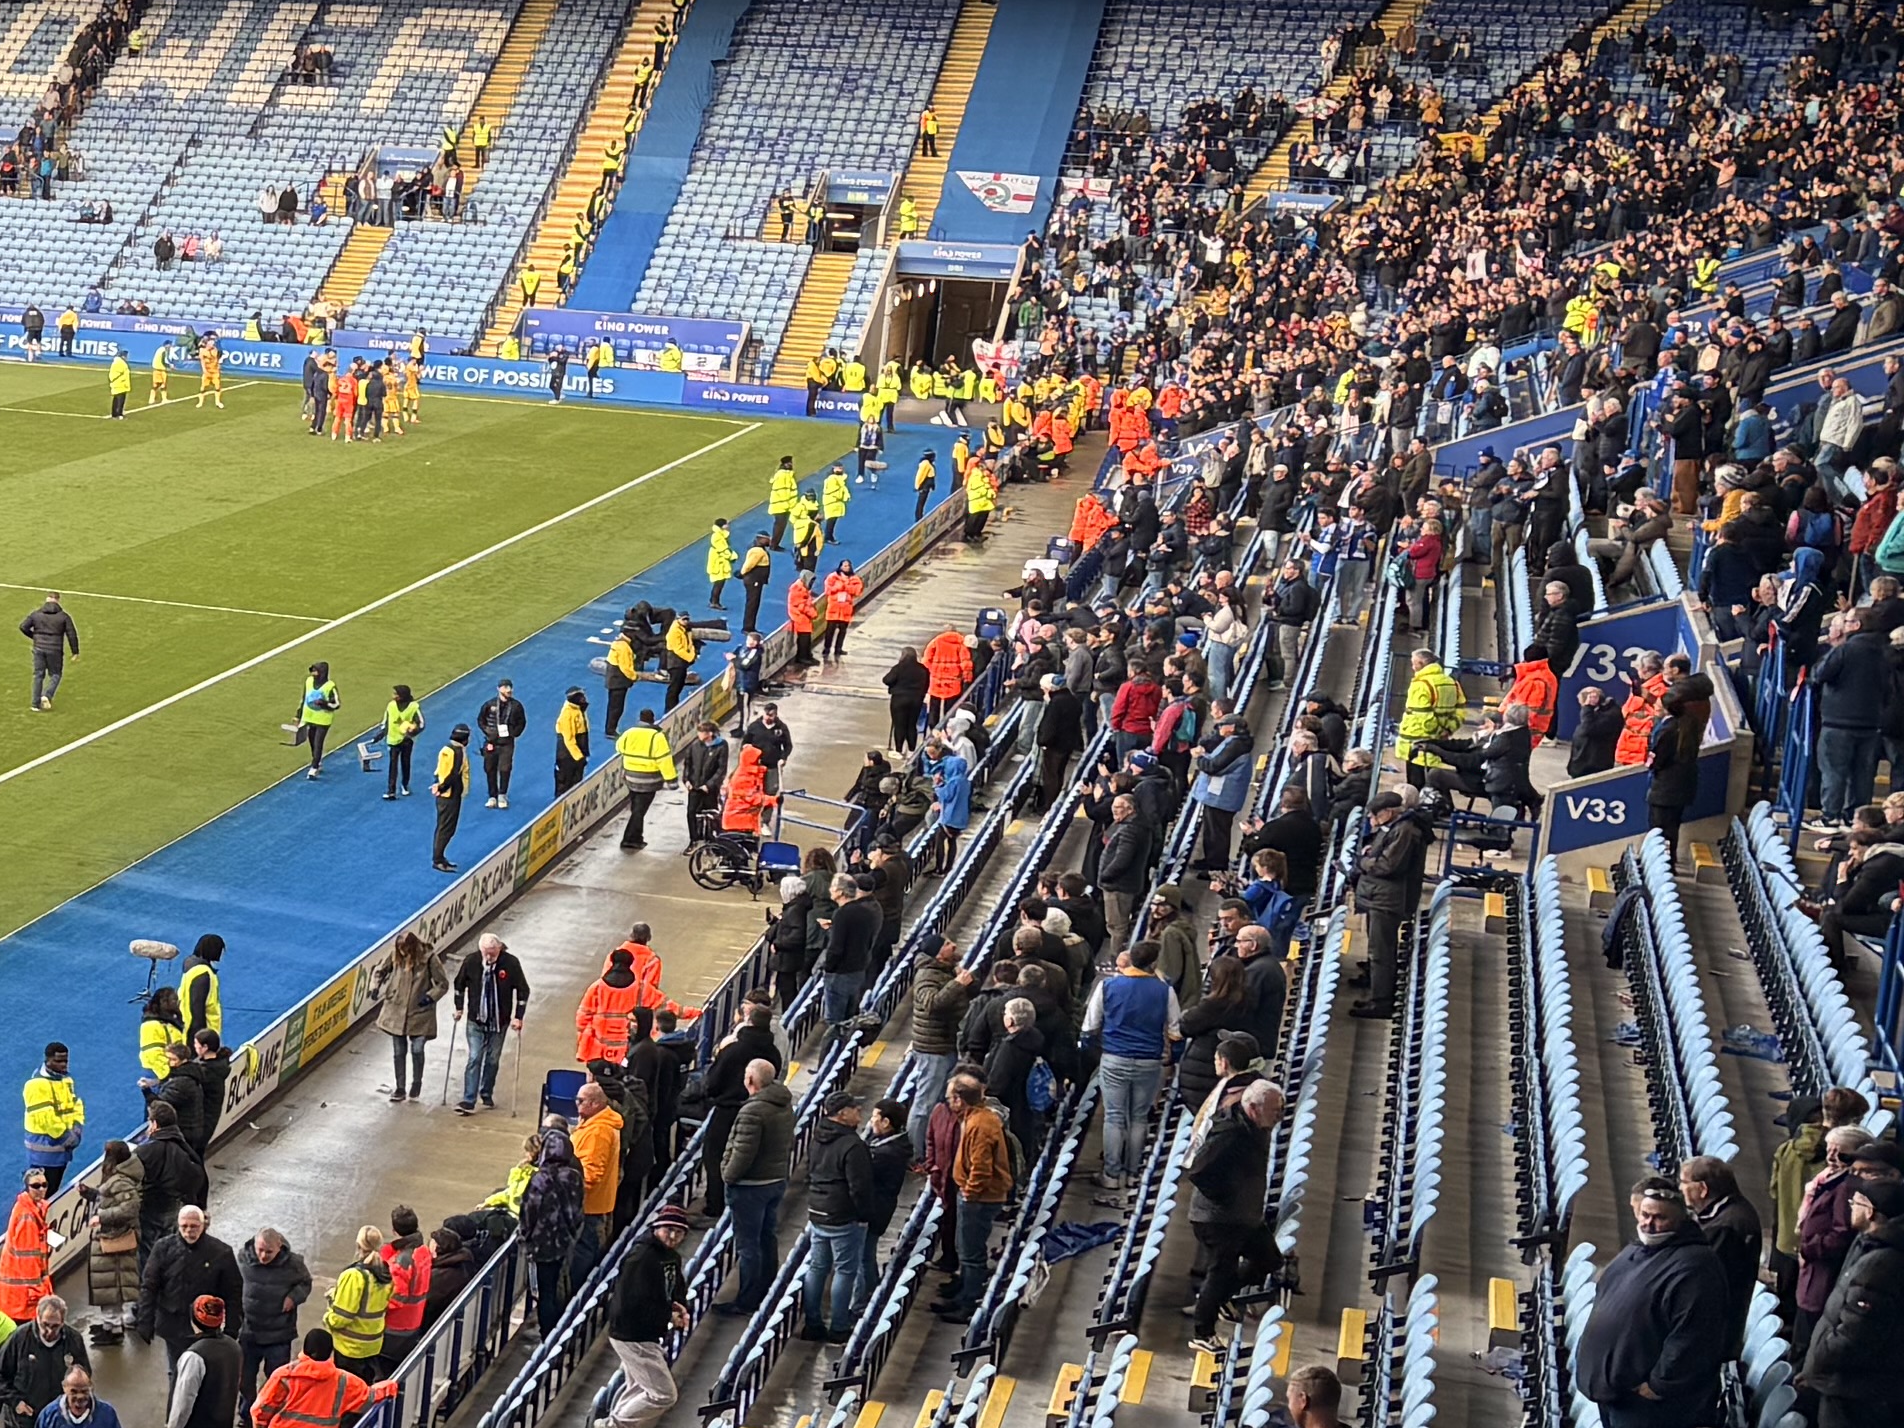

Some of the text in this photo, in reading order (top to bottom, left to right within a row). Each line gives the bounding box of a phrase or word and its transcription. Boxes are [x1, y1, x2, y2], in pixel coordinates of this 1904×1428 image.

[595, 320, 669, 335] KING POWER
[464, 367, 490, 384] OF
[702, 390, 770, 404] KING POWER
[1566, 795, 1626, 825] V33
